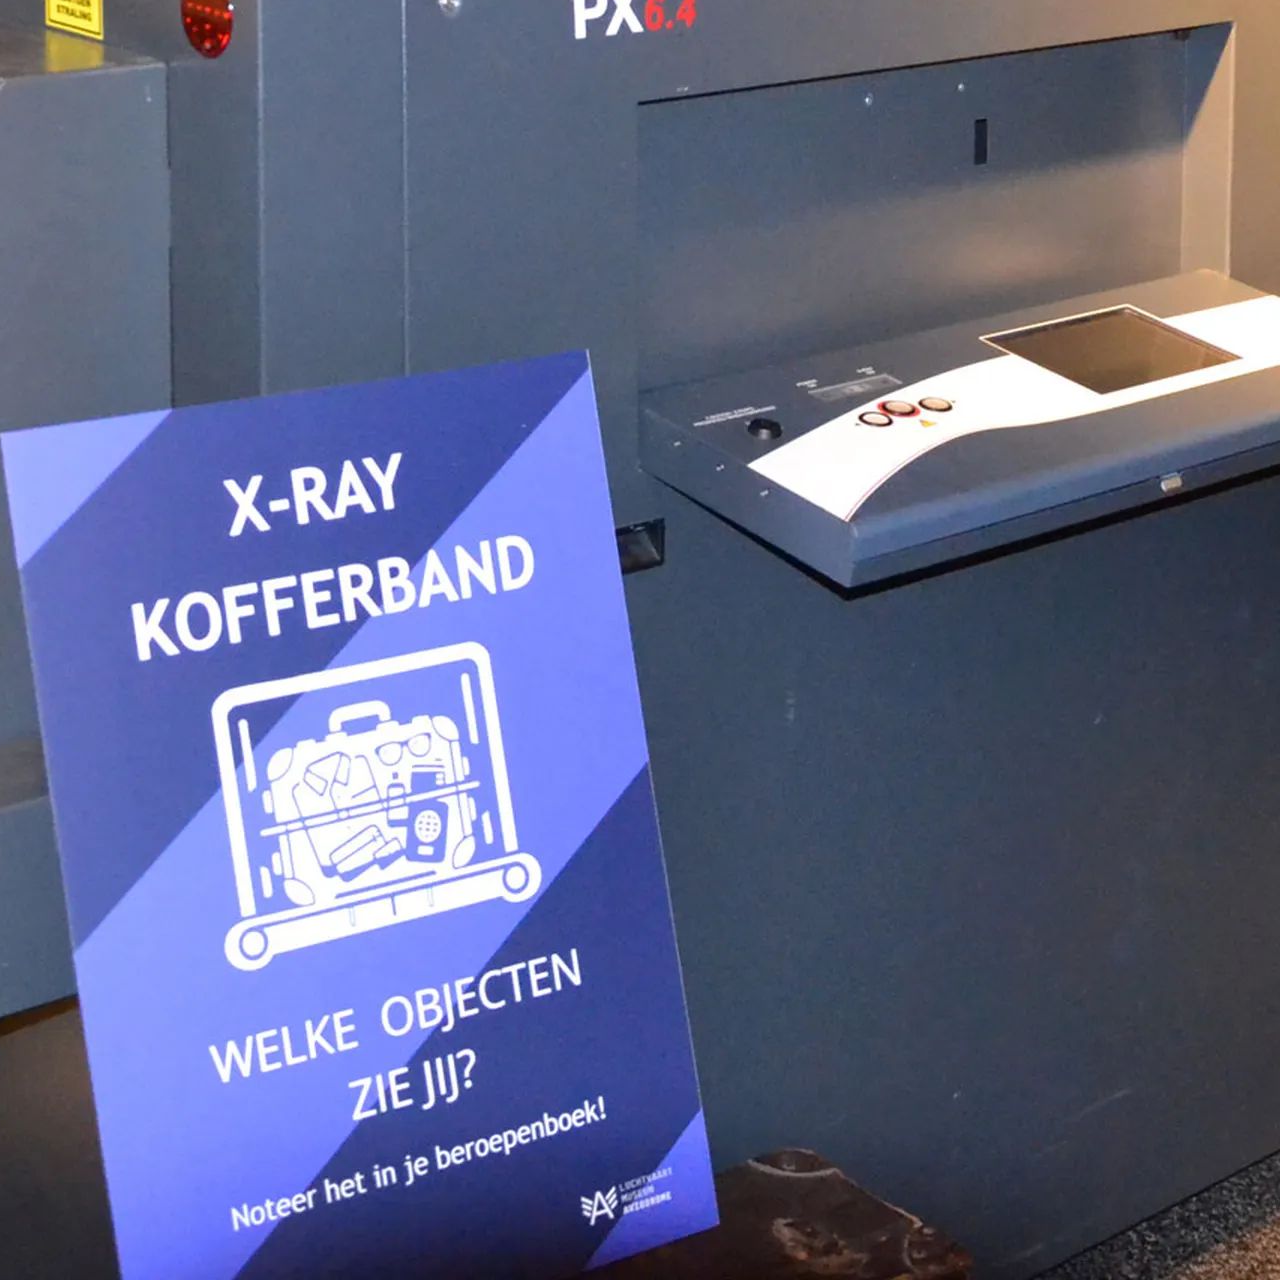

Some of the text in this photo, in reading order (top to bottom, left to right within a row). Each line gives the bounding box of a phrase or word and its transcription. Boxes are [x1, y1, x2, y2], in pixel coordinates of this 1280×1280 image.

[56, 4, 92, 22] STRALING
[223, 452, 403, 538] X-RAY
[130, 534, 536, 662] KOFFERBAND
[207, 948, 582, 1084] WELKE OBJECTEN
[347, 1048, 477, 1121] ZIE JIJ?
[230, 1095, 607, 1232] Noteer het in je beroepenboek!
[619, 1167, 673, 1192] LUCHTVAART
